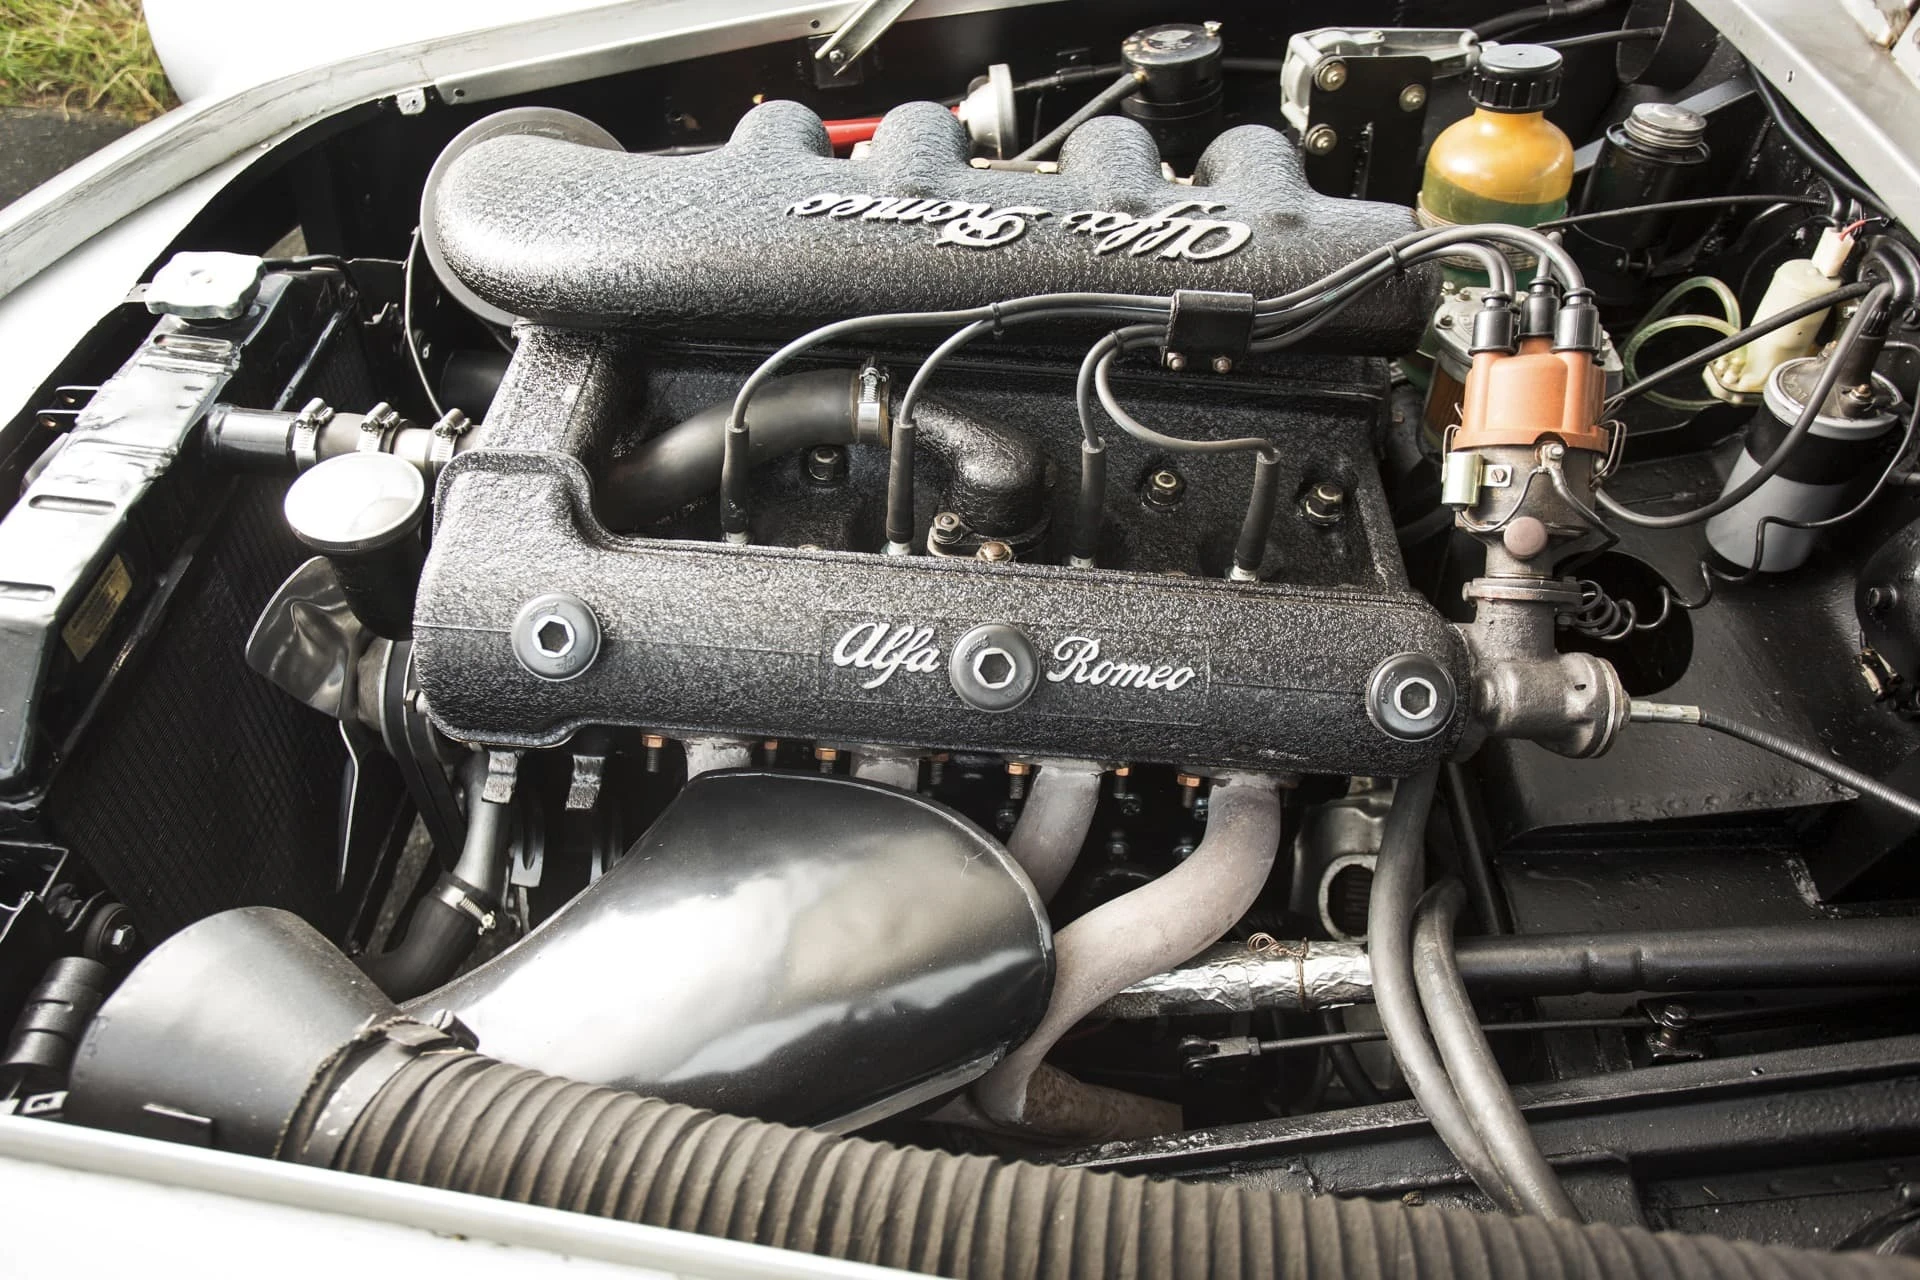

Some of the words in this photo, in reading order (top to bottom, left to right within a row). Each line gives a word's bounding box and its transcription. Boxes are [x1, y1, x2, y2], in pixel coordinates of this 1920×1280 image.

[786, 193, 1051, 247] Romeo
[1060, 200, 1253, 261] Alfa
[833, 622, 940, 689] Alfa
[1046, 635, 1195, 691] Romeo
